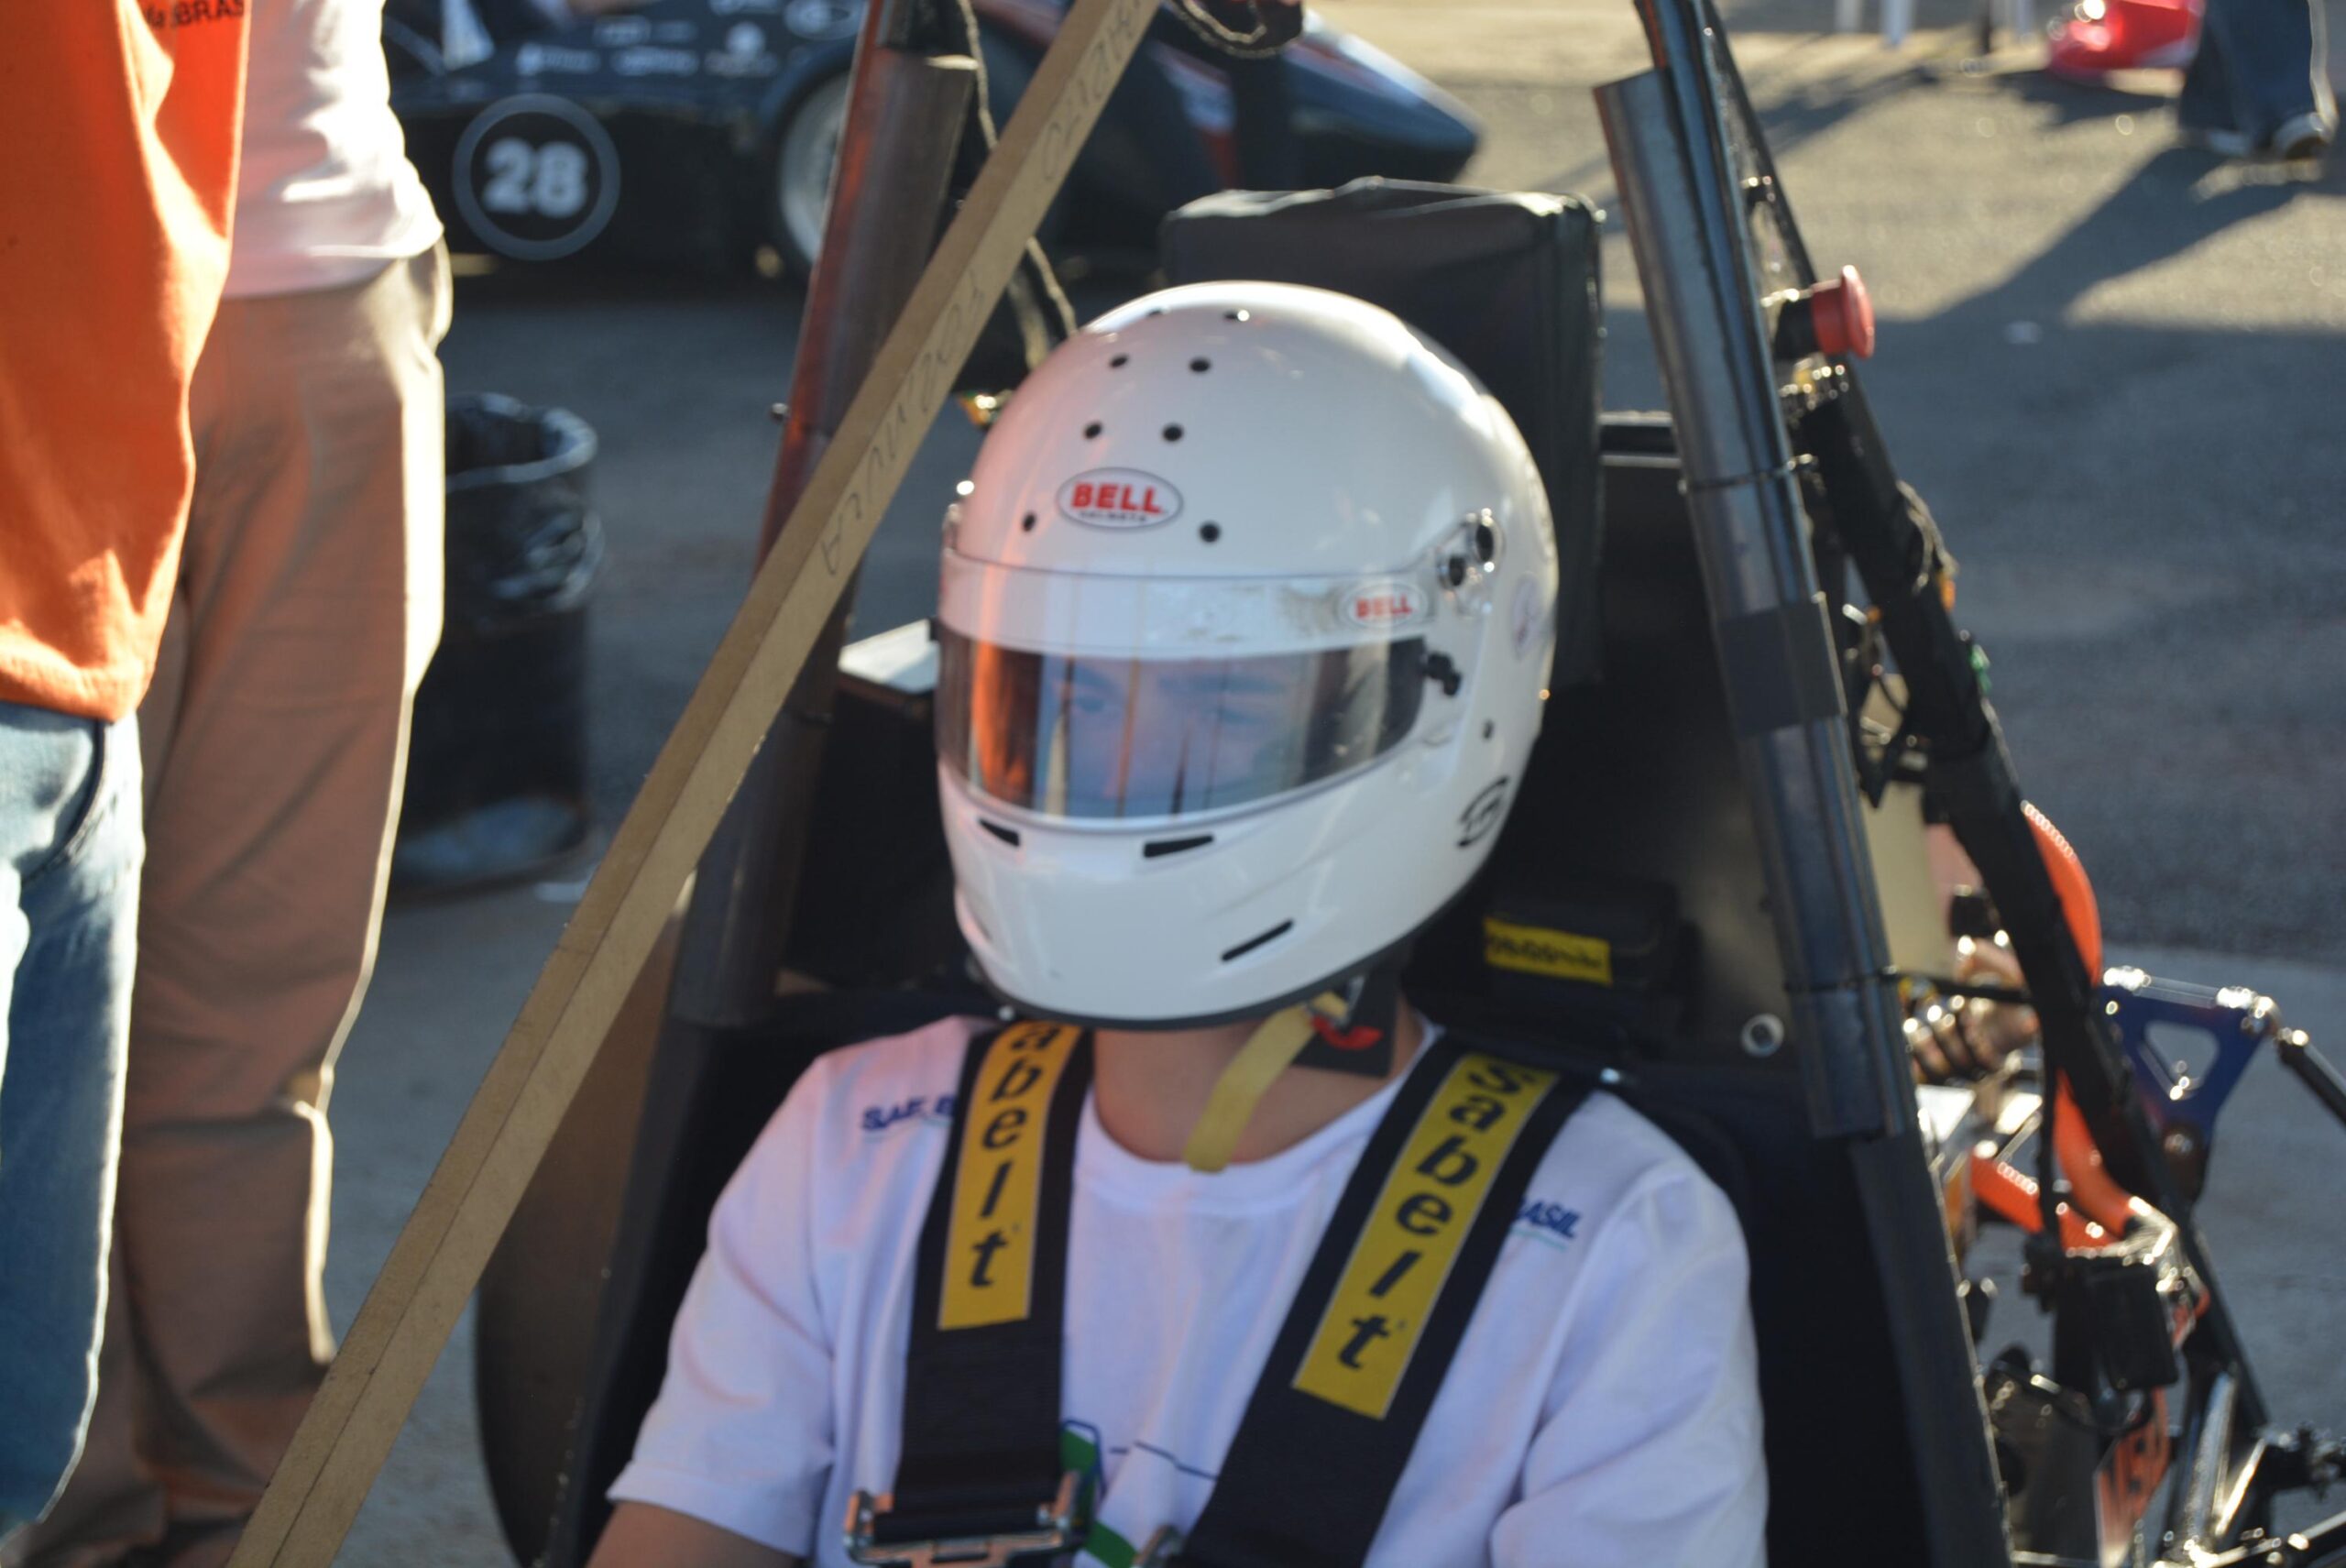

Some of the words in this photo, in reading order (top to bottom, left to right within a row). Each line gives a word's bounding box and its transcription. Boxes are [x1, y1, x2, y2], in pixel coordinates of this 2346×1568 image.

[484, 138, 588, 217] 28
[1071, 482, 1164, 516] BELL
[1518, 1200, 1580, 1239] ASIL
